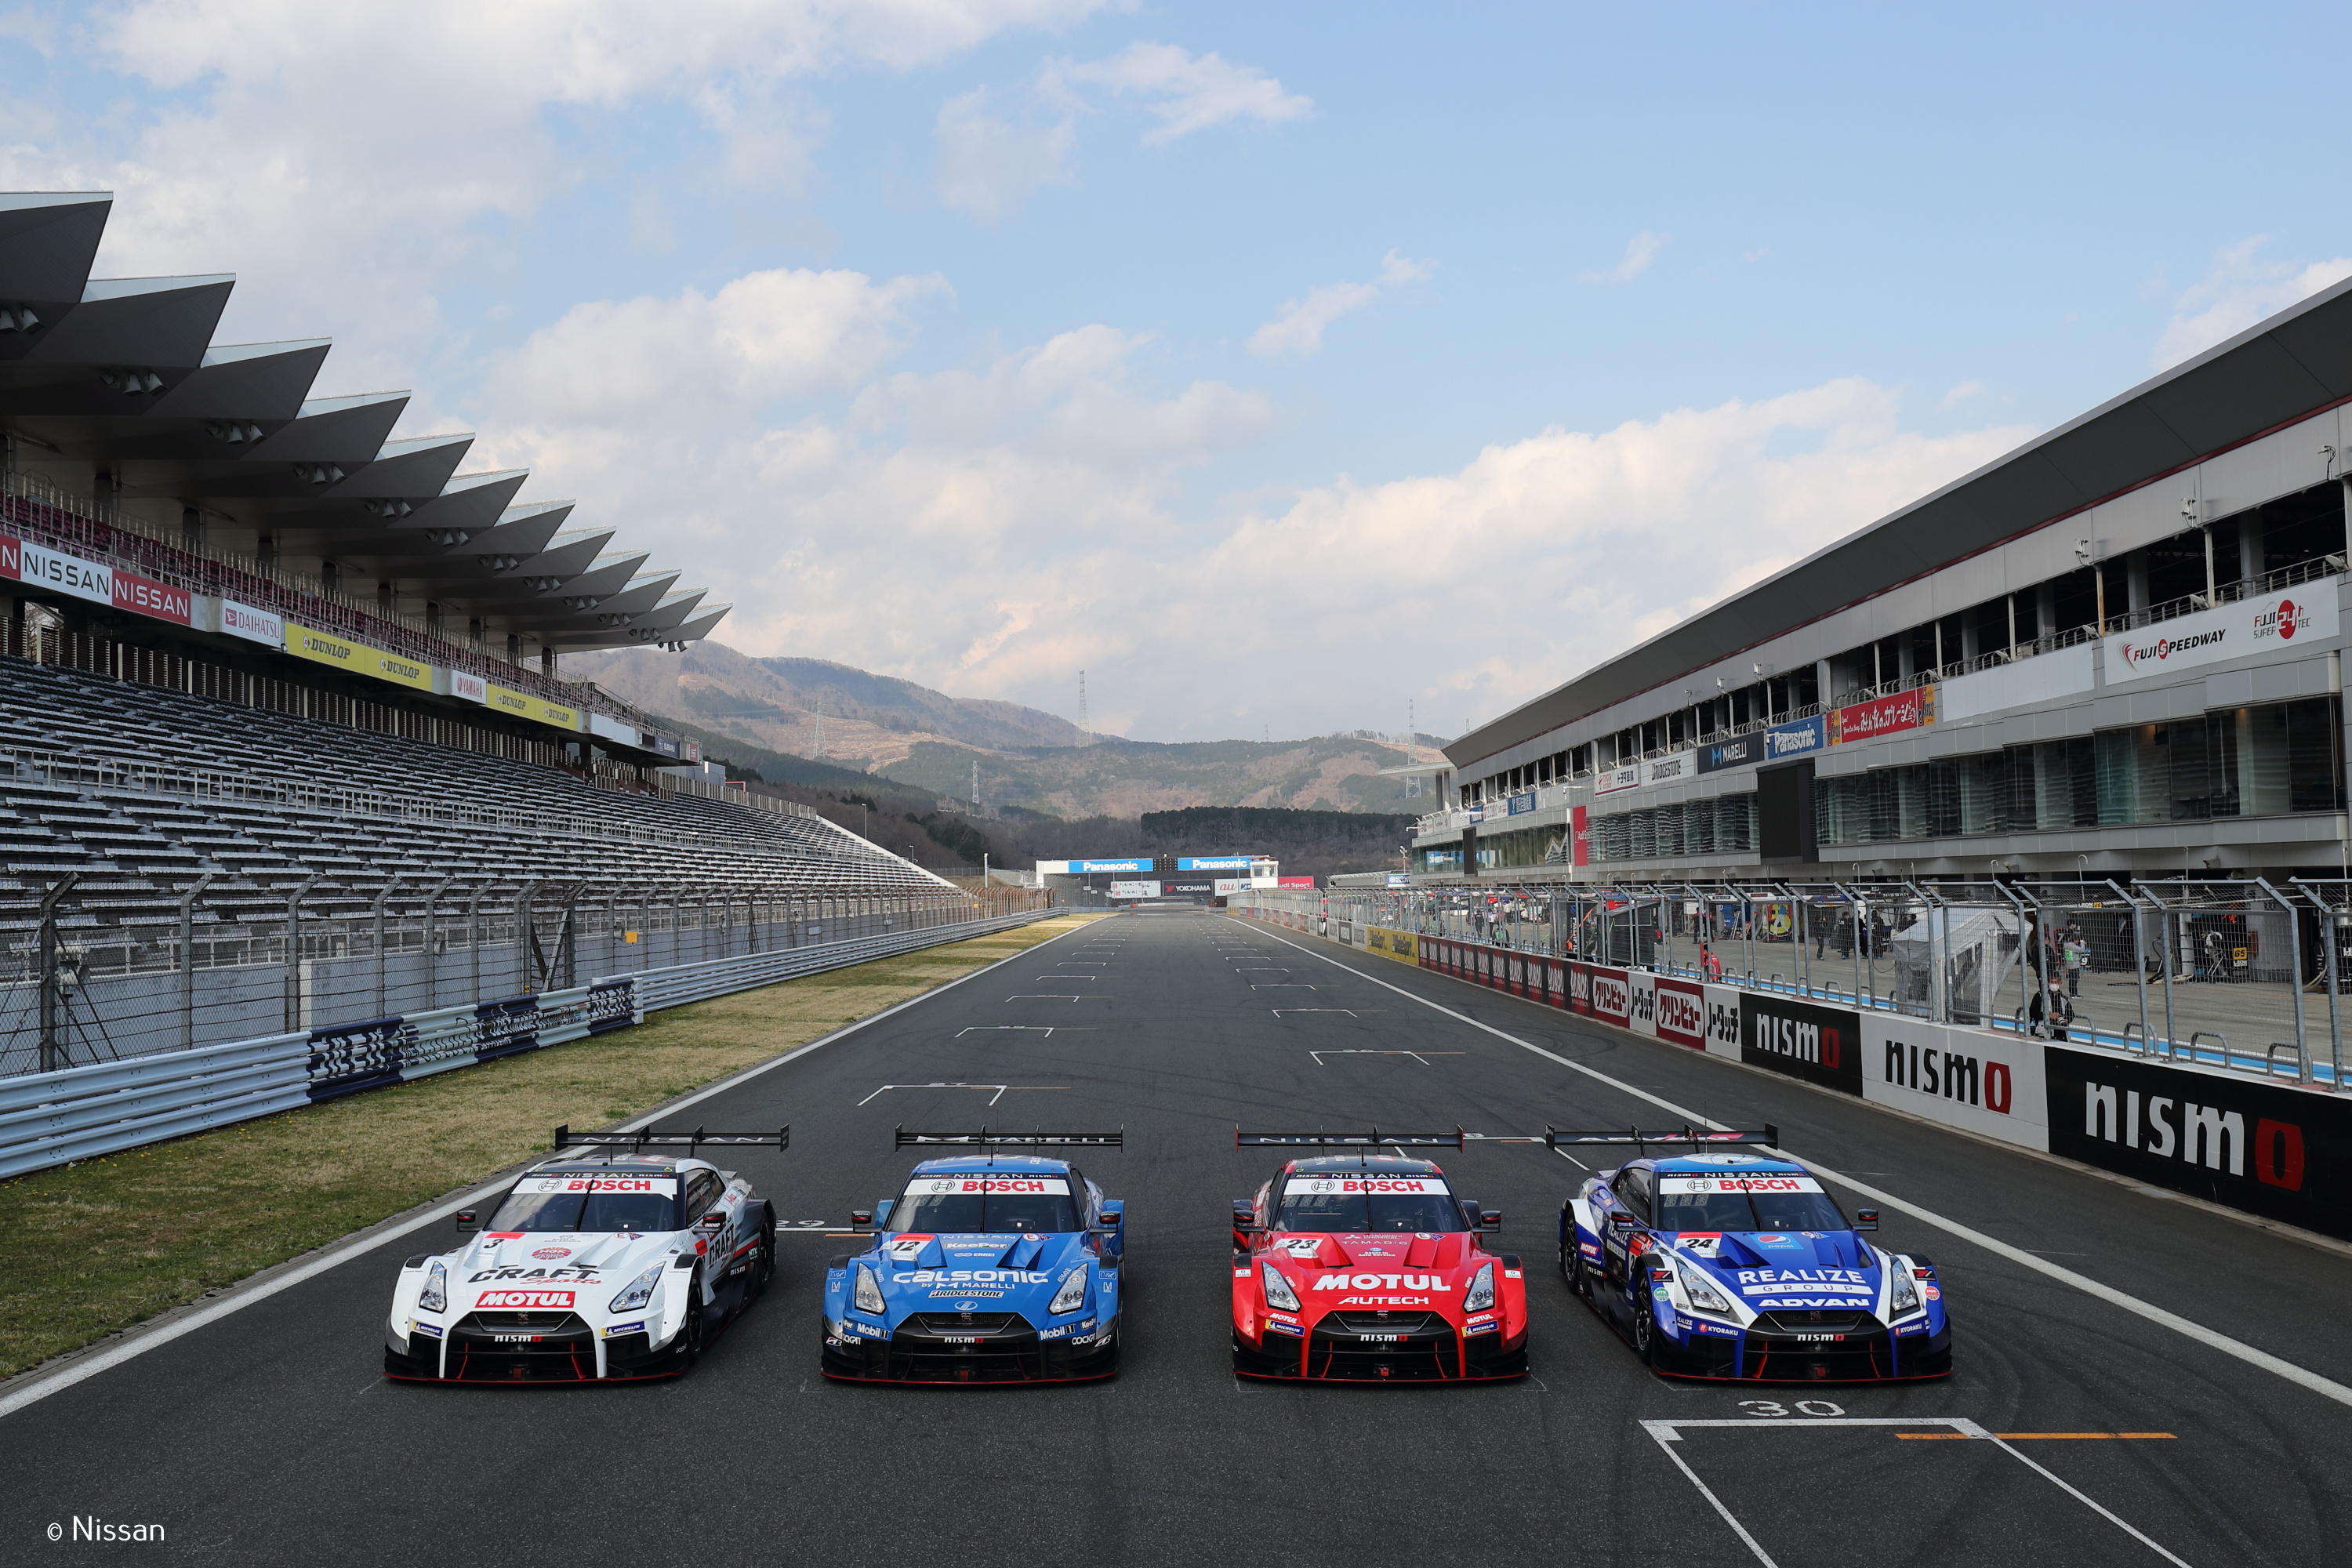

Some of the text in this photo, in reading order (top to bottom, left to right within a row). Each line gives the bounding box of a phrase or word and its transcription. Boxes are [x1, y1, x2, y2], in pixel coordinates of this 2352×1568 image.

[24, 551, 109, 596] NISSAN
[115, 580, 188, 619] NISSAN
[238, 612, 280, 639] DAIHATSU
[2254, 612, 2276, 627] FUJI
[2254, 617, 2311, 639] SUPER TEC
[311, 638, 350, 659] DUNLOP
[2134, 629, 2226, 662] FUJI SPEEDWAY
[387, 660, 419, 680] DUNLOP
[463, 680, 483, 699] YAMAHA
[502, 695, 526, 710] DUNLOP
[548, 708, 570, 723] DUNLOP
[1775, 723, 1816, 753] Panasonic
[1722, 741, 1747, 762] MARELLI
[1652, 759, 1682, 781] BRIDGESTONE
[1083, 861, 1138, 871] Panasonic
[1192, 858, 1247, 869] Panasonic
[1219, 883, 1238, 891] au
[2234, 949, 2246, 957] 65
[1659, 993, 1700, 1032] クリンビュー
[1755, 1013, 1840, 1069] nismo
[1885, 1040, 2012, 1115] nismo
[2085, 1081, 2305, 1192] nismo
[567, 1180, 651, 1191] BOSCH
[962, 1181, 1044, 1192] BOSCH
[1343, 1181, 1425, 1192] BOSCH
[1719, 1179, 1800, 1190] BOSCH
[484, 1238, 503, 1249] 3
[709, 1223, 735, 1269] CRAFT
[892, 1240, 919, 1251] 12
[1287, 1239, 1317, 1250] 23
[1581, 1243, 1597, 1254] MOTUL
[1686, 1239, 1714, 1249] 24
[748, 1247, 758, 1257] NTK
[467, 1268, 600, 1283] CRAFT
[1057, 1268, 1072, 1283] KENWOOD
[1588, 1265, 1607, 1279] nismo
[1737, 1269, 1866, 1284] REALIZE
[518, 1276, 604, 1286] Sports
[1312, 1273, 1451, 1291] MOTUL
[478, 1292, 573, 1306] MOTUL
[931, 1290, 1004, 1298] BRIDGESTONE
[1759, 1298, 1871, 1307] ADVAN
[1269, 1312, 1298, 1324] MOTUL
[1466, 1313, 1494, 1324] MOTUL
[1677, 1316, 1693, 1326] REALIZE
[613, 1324, 641, 1333] MICHELIN
[857, 1323, 880, 1338] Mobil
[1040, 1327, 1065, 1341] Mobil
[1276, 1324, 1301, 1333] MICHELIN
[1472, 1323, 1494, 1333] MICHELIN
[1708, 1325, 1739, 1336] KYORAKU
[1900, 1323, 1922, 1334] KYORAKU
[1737, 1400, 1846, 1417] 30
